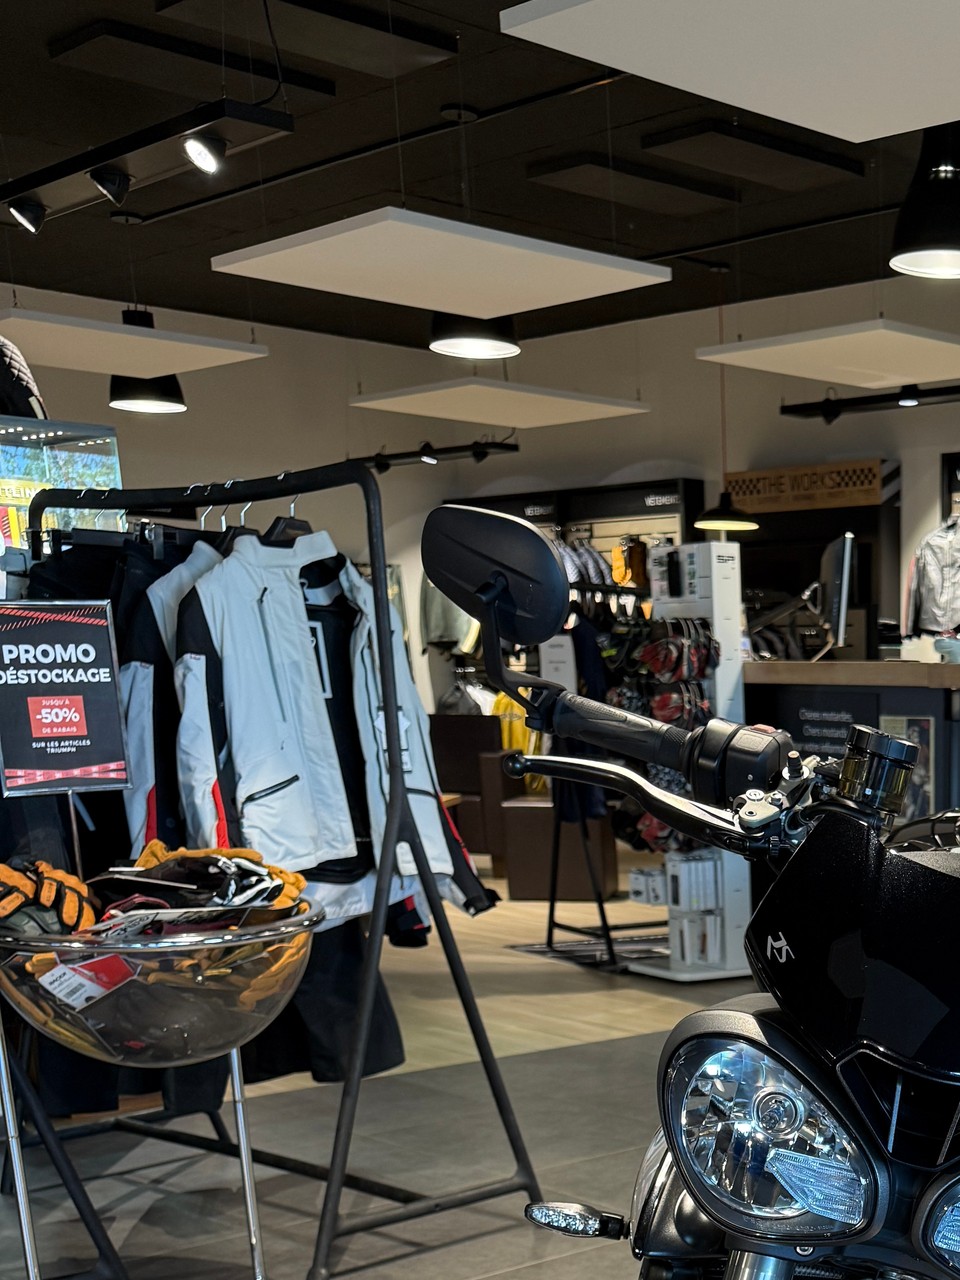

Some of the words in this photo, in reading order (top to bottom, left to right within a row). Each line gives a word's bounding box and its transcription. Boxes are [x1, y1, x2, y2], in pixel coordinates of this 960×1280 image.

[2, 643, 96, 664] PROMO
[36, 707, 80, 723] -50%
[46, 746, 77, 754] TRIUMPH
